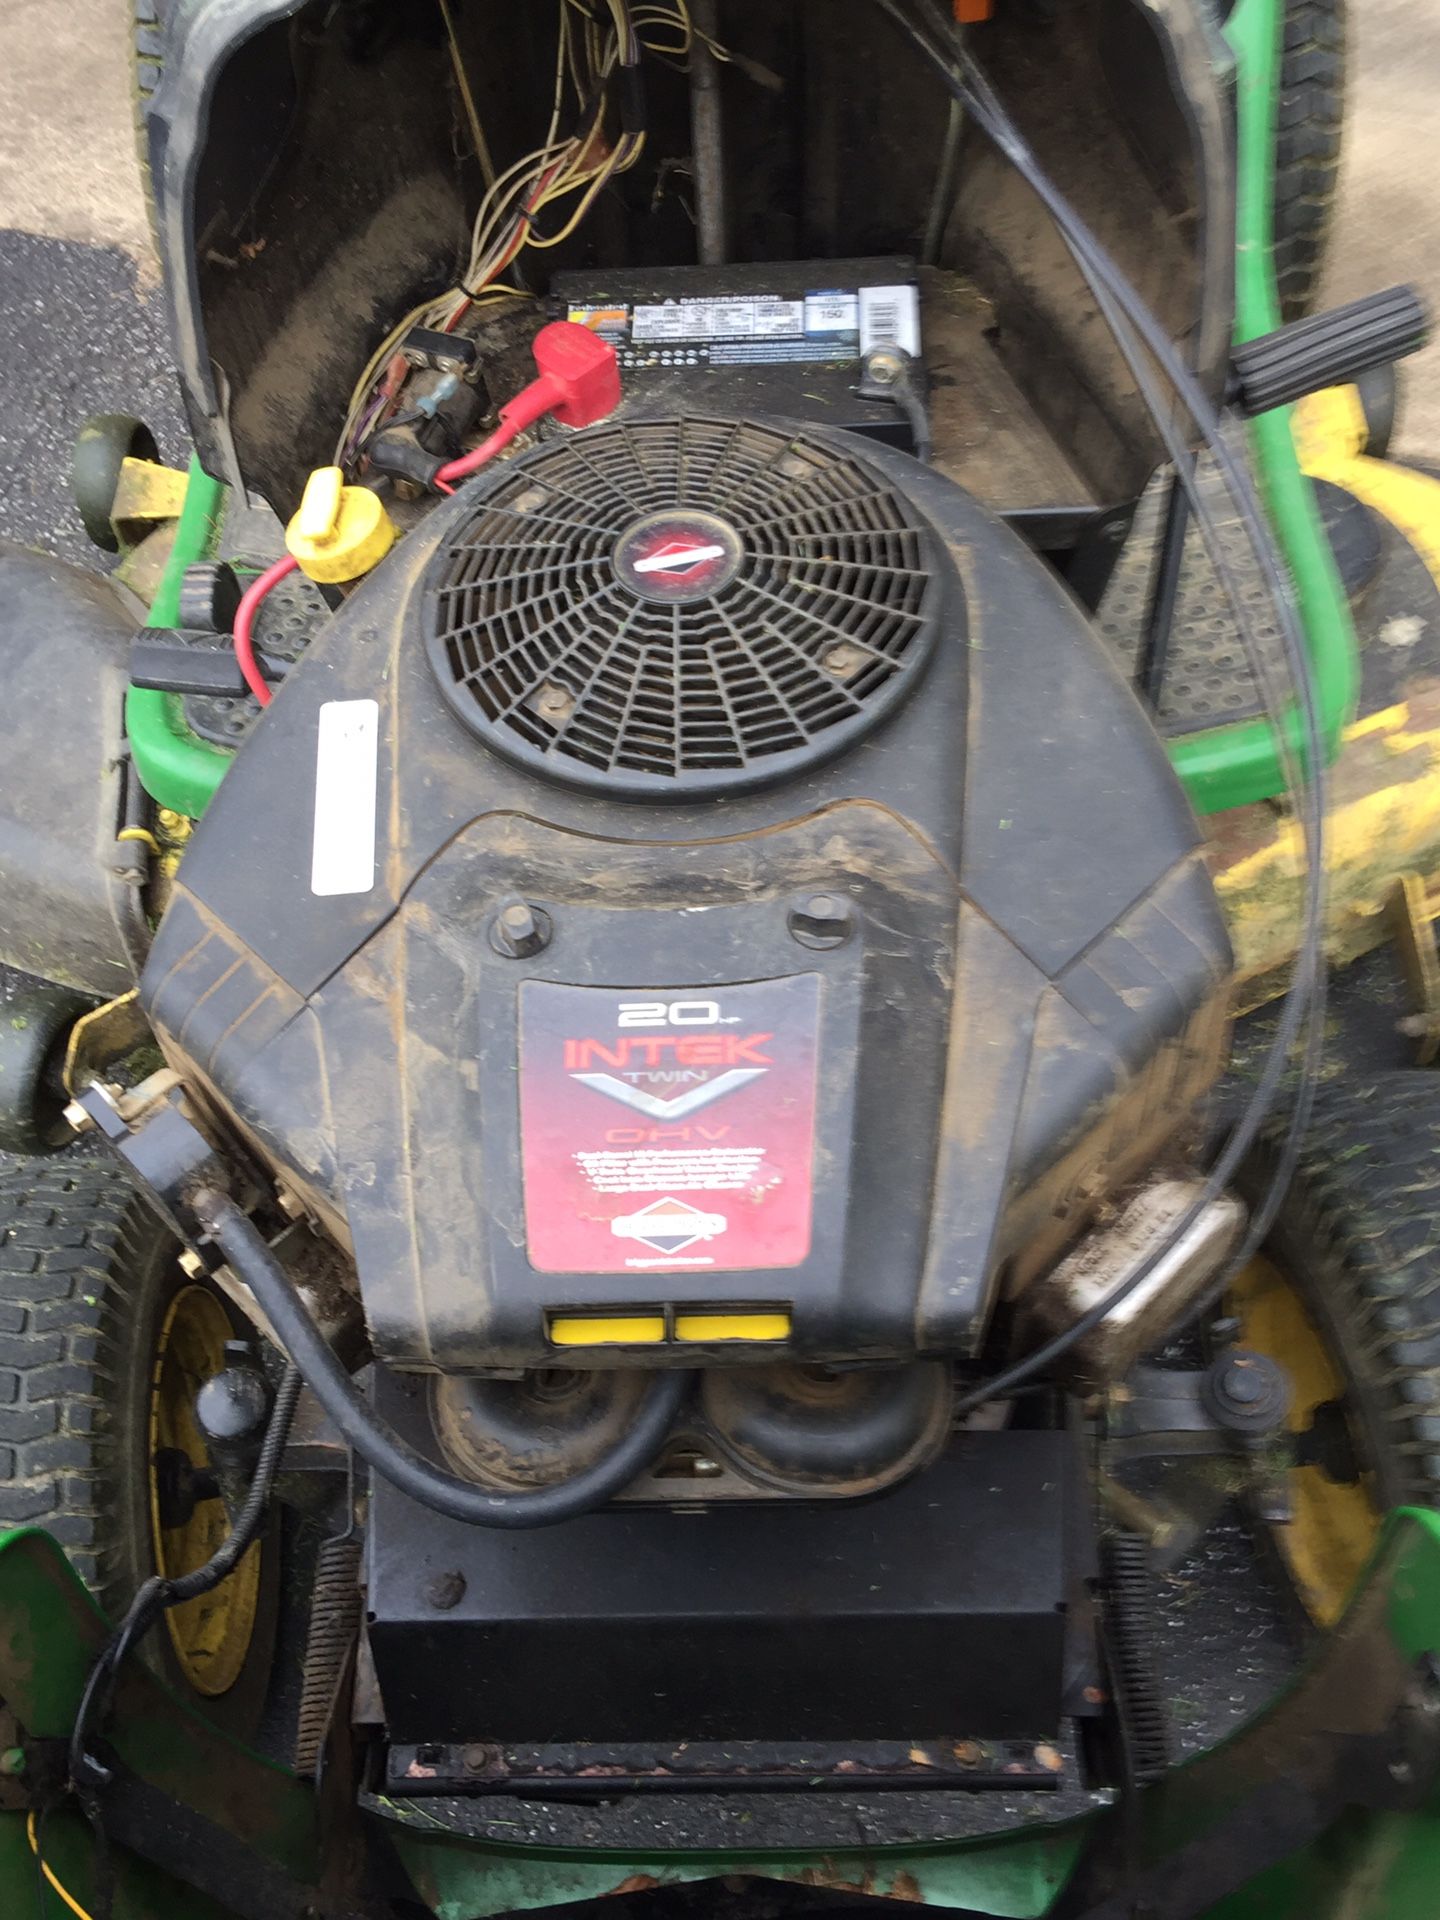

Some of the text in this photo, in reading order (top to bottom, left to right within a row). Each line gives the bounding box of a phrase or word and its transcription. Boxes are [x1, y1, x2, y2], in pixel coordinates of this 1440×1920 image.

[618, 1001, 719, 1027] 20
[564, 1034, 774, 1068] INTEK
[622, 1069, 708, 1084] TWIN
[605, 1126, 730, 1143] OHV
